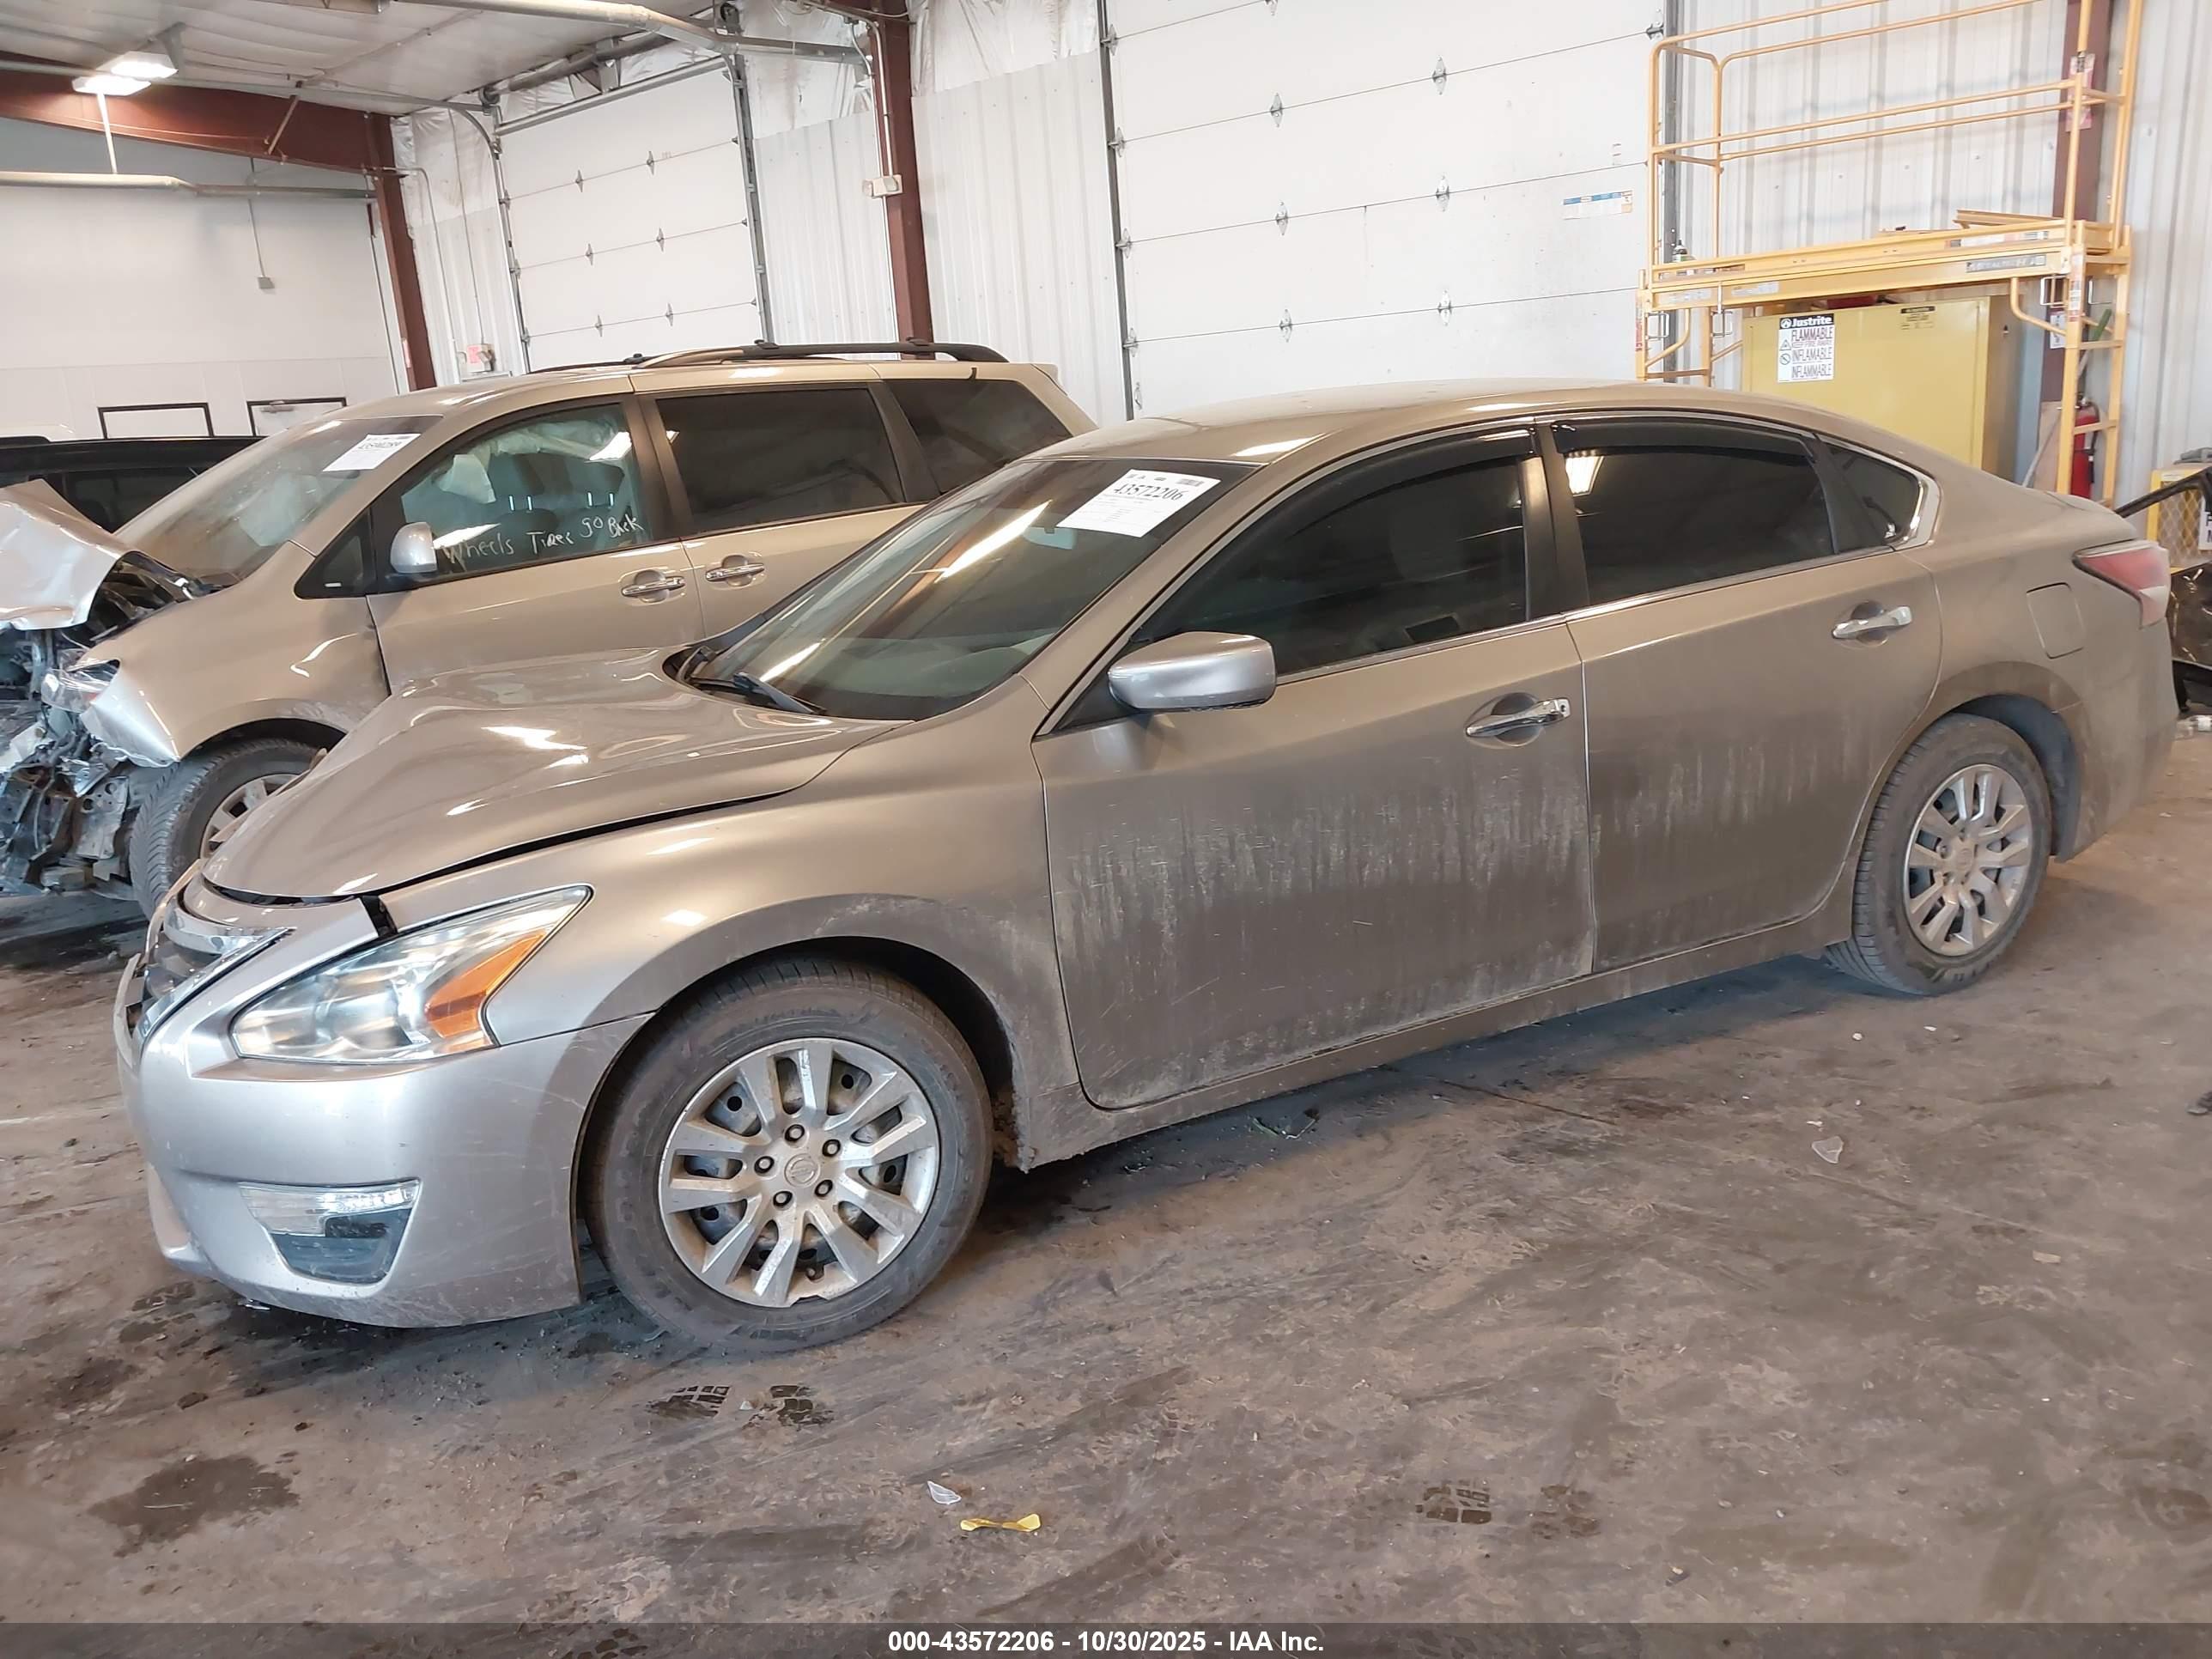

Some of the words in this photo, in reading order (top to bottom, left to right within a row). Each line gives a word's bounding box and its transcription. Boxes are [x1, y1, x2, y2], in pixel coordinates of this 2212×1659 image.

[1792, 316, 1832, 327] Justrite
[1792, 326, 1832, 342] FLAMMABLE
[1792, 346, 1832, 362] INFLAMABLE
[1792, 363, 1832, 378] INFLAMMABLE
[1114, 483, 1188, 501] 43572206
